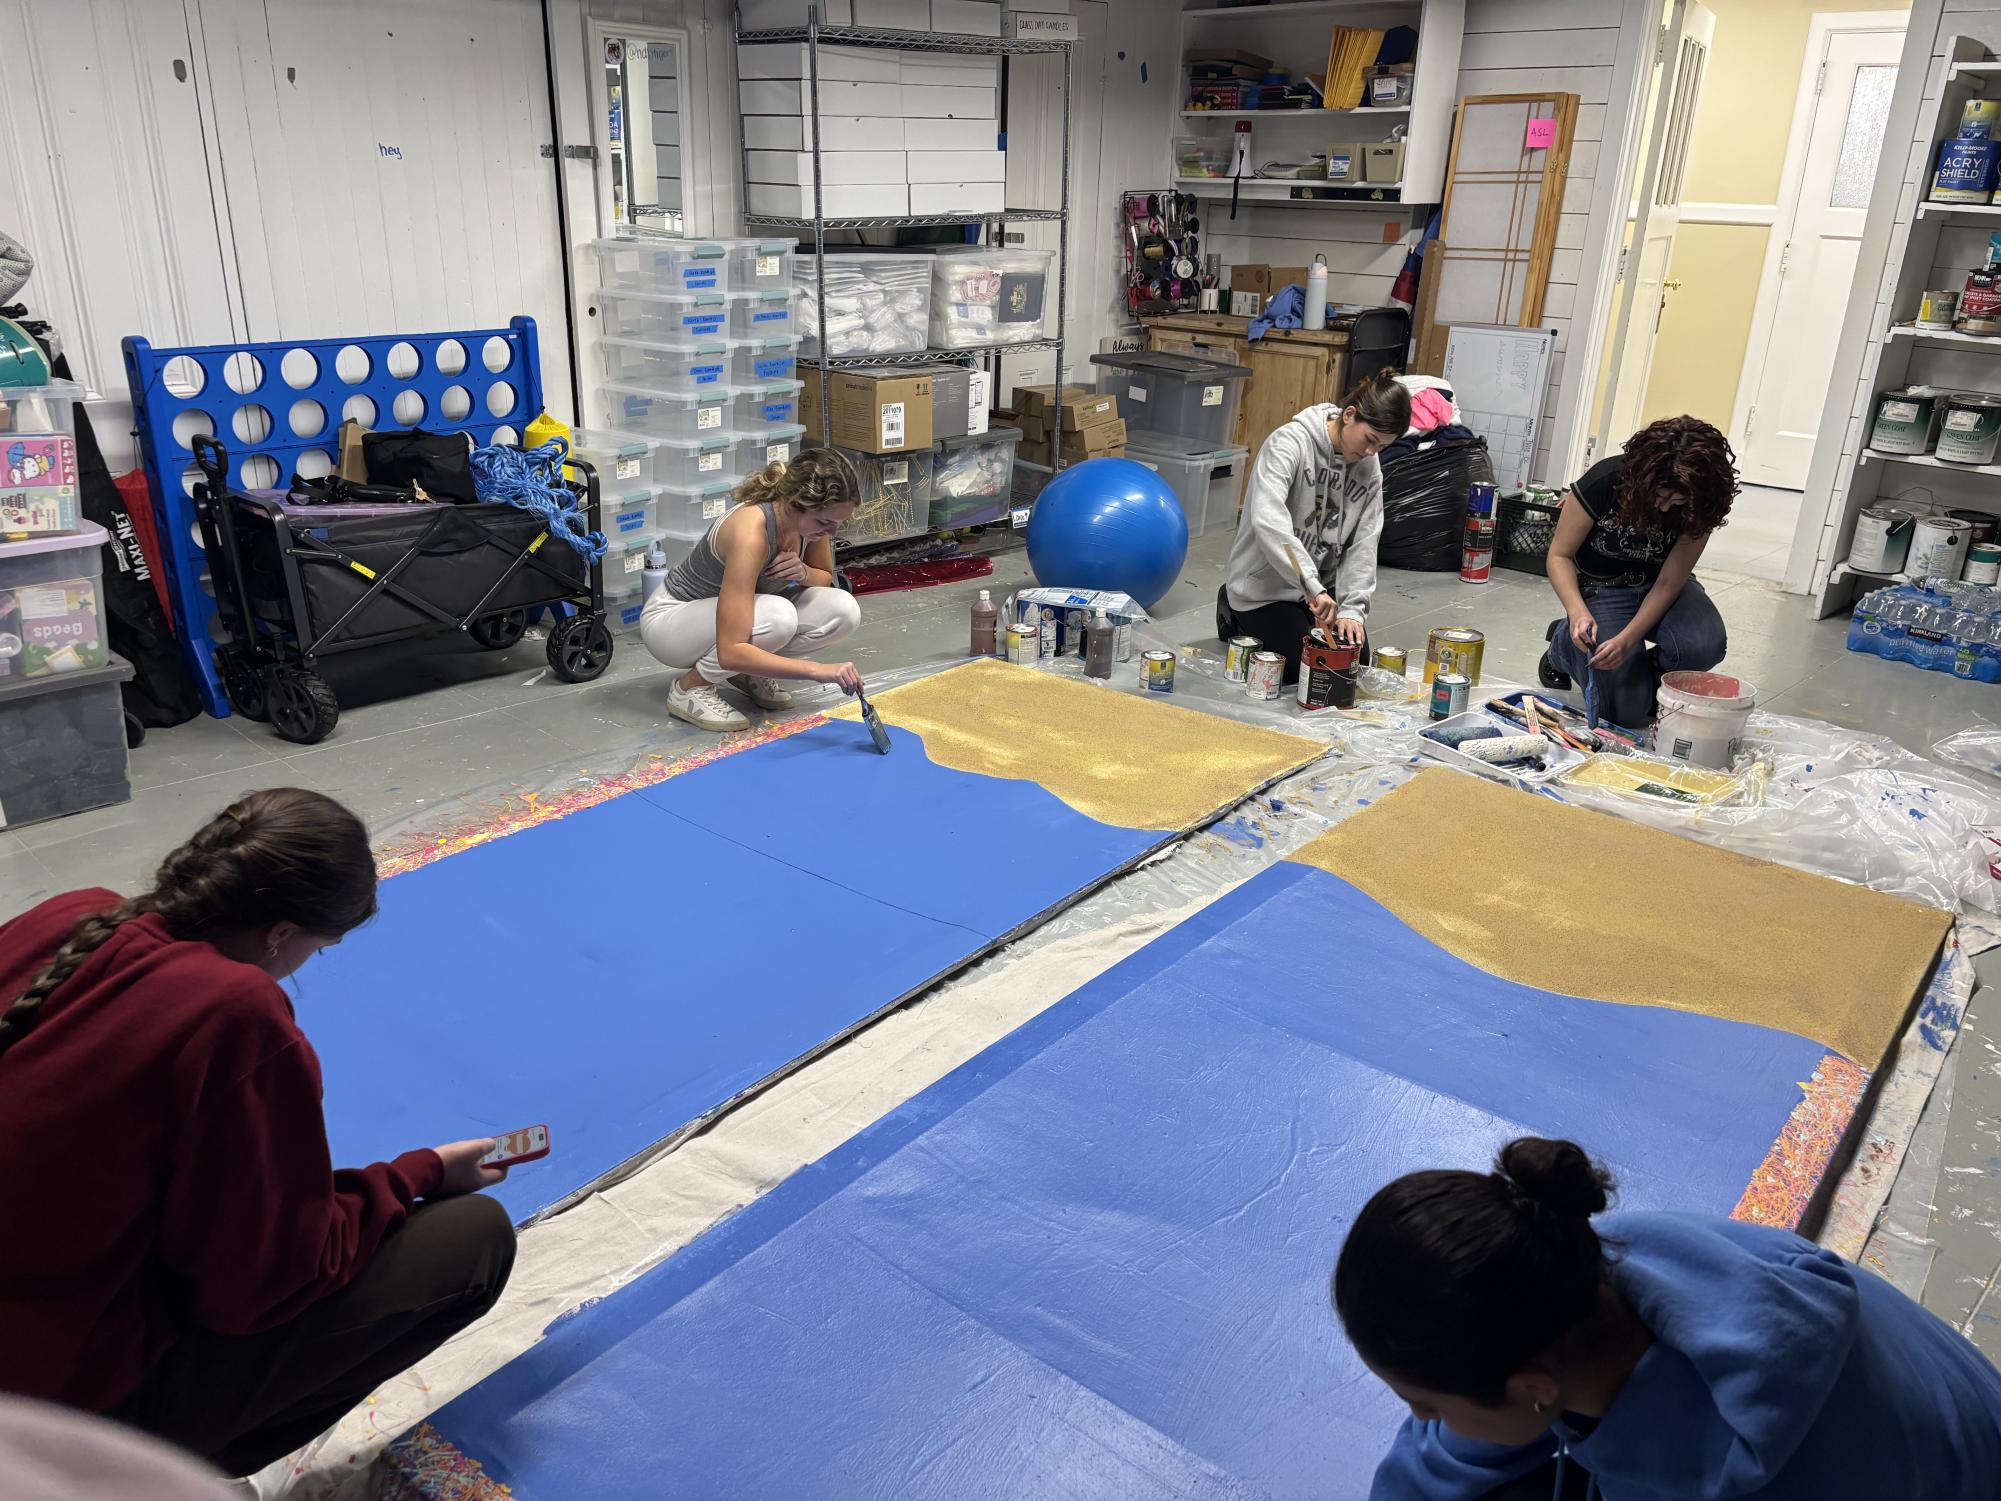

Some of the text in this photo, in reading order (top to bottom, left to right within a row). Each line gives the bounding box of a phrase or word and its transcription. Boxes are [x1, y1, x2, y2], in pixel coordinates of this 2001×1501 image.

[1046, 20, 1069, 31] CANDLES
[1530, 127, 1549, 137] ASL
[378, 141, 402, 160] hey
[1943, 157, 1984, 168] ACRY
[1940, 168, 1979, 179] SHIELD
[1112, 339, 1144, 355] Always
[113, 513, 151, 581] MAXI-NET
[33, 622, 82, 639] Beads
[1909, 628, 1942, 639] KIRKLAND
[1889, 639, 1953, 656] purified water
